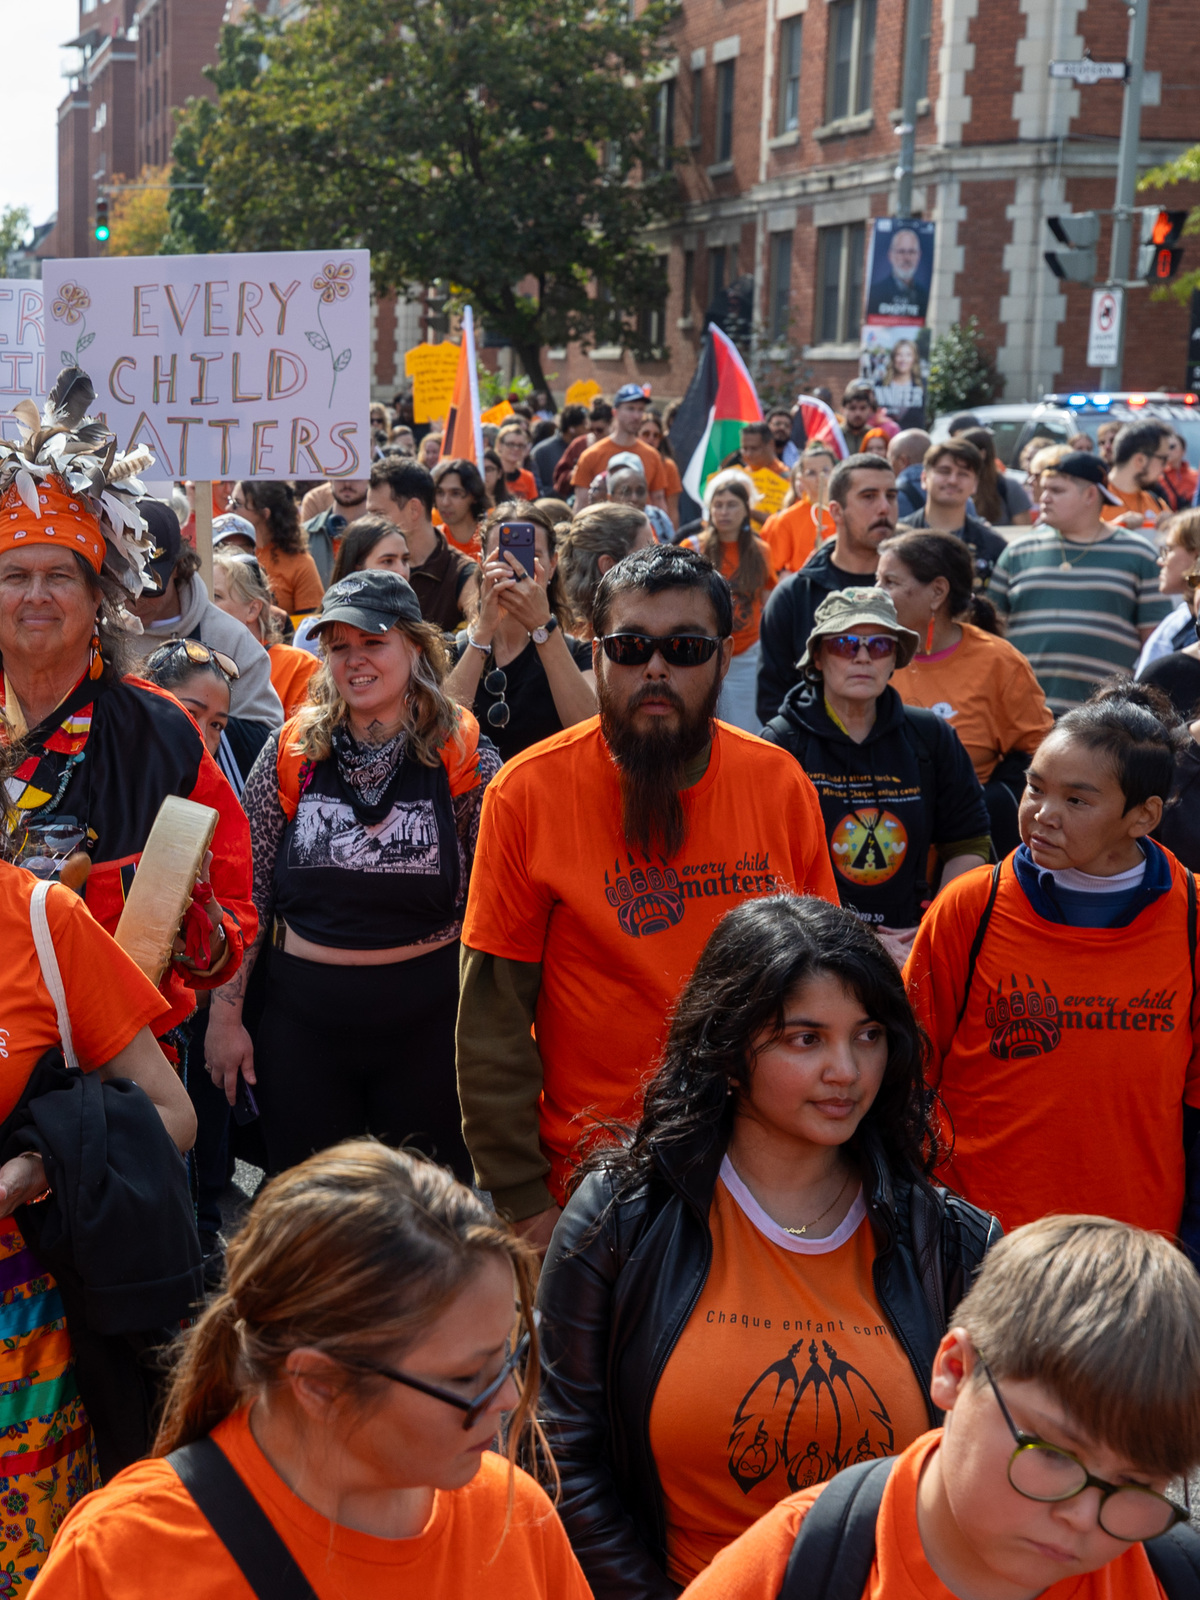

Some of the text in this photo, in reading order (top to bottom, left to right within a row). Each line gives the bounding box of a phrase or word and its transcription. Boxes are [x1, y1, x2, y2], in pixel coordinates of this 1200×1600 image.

[133, 280, 301, 337] EVERY
[109, 349, 307, 405] CHILD
[98, 411, 360, 477] ATTERS
[806, 772, 826, 781] very
[681, 852, 770, 876] every child
[677, 872, 777, 900] matters
[872, 913, 885, 923] 30
[1063, 989, 1177, 1010] every child
[1056, 1008, 1175, 1032] matters
[706, 1310, 894, 1339] Chaque enfant com
